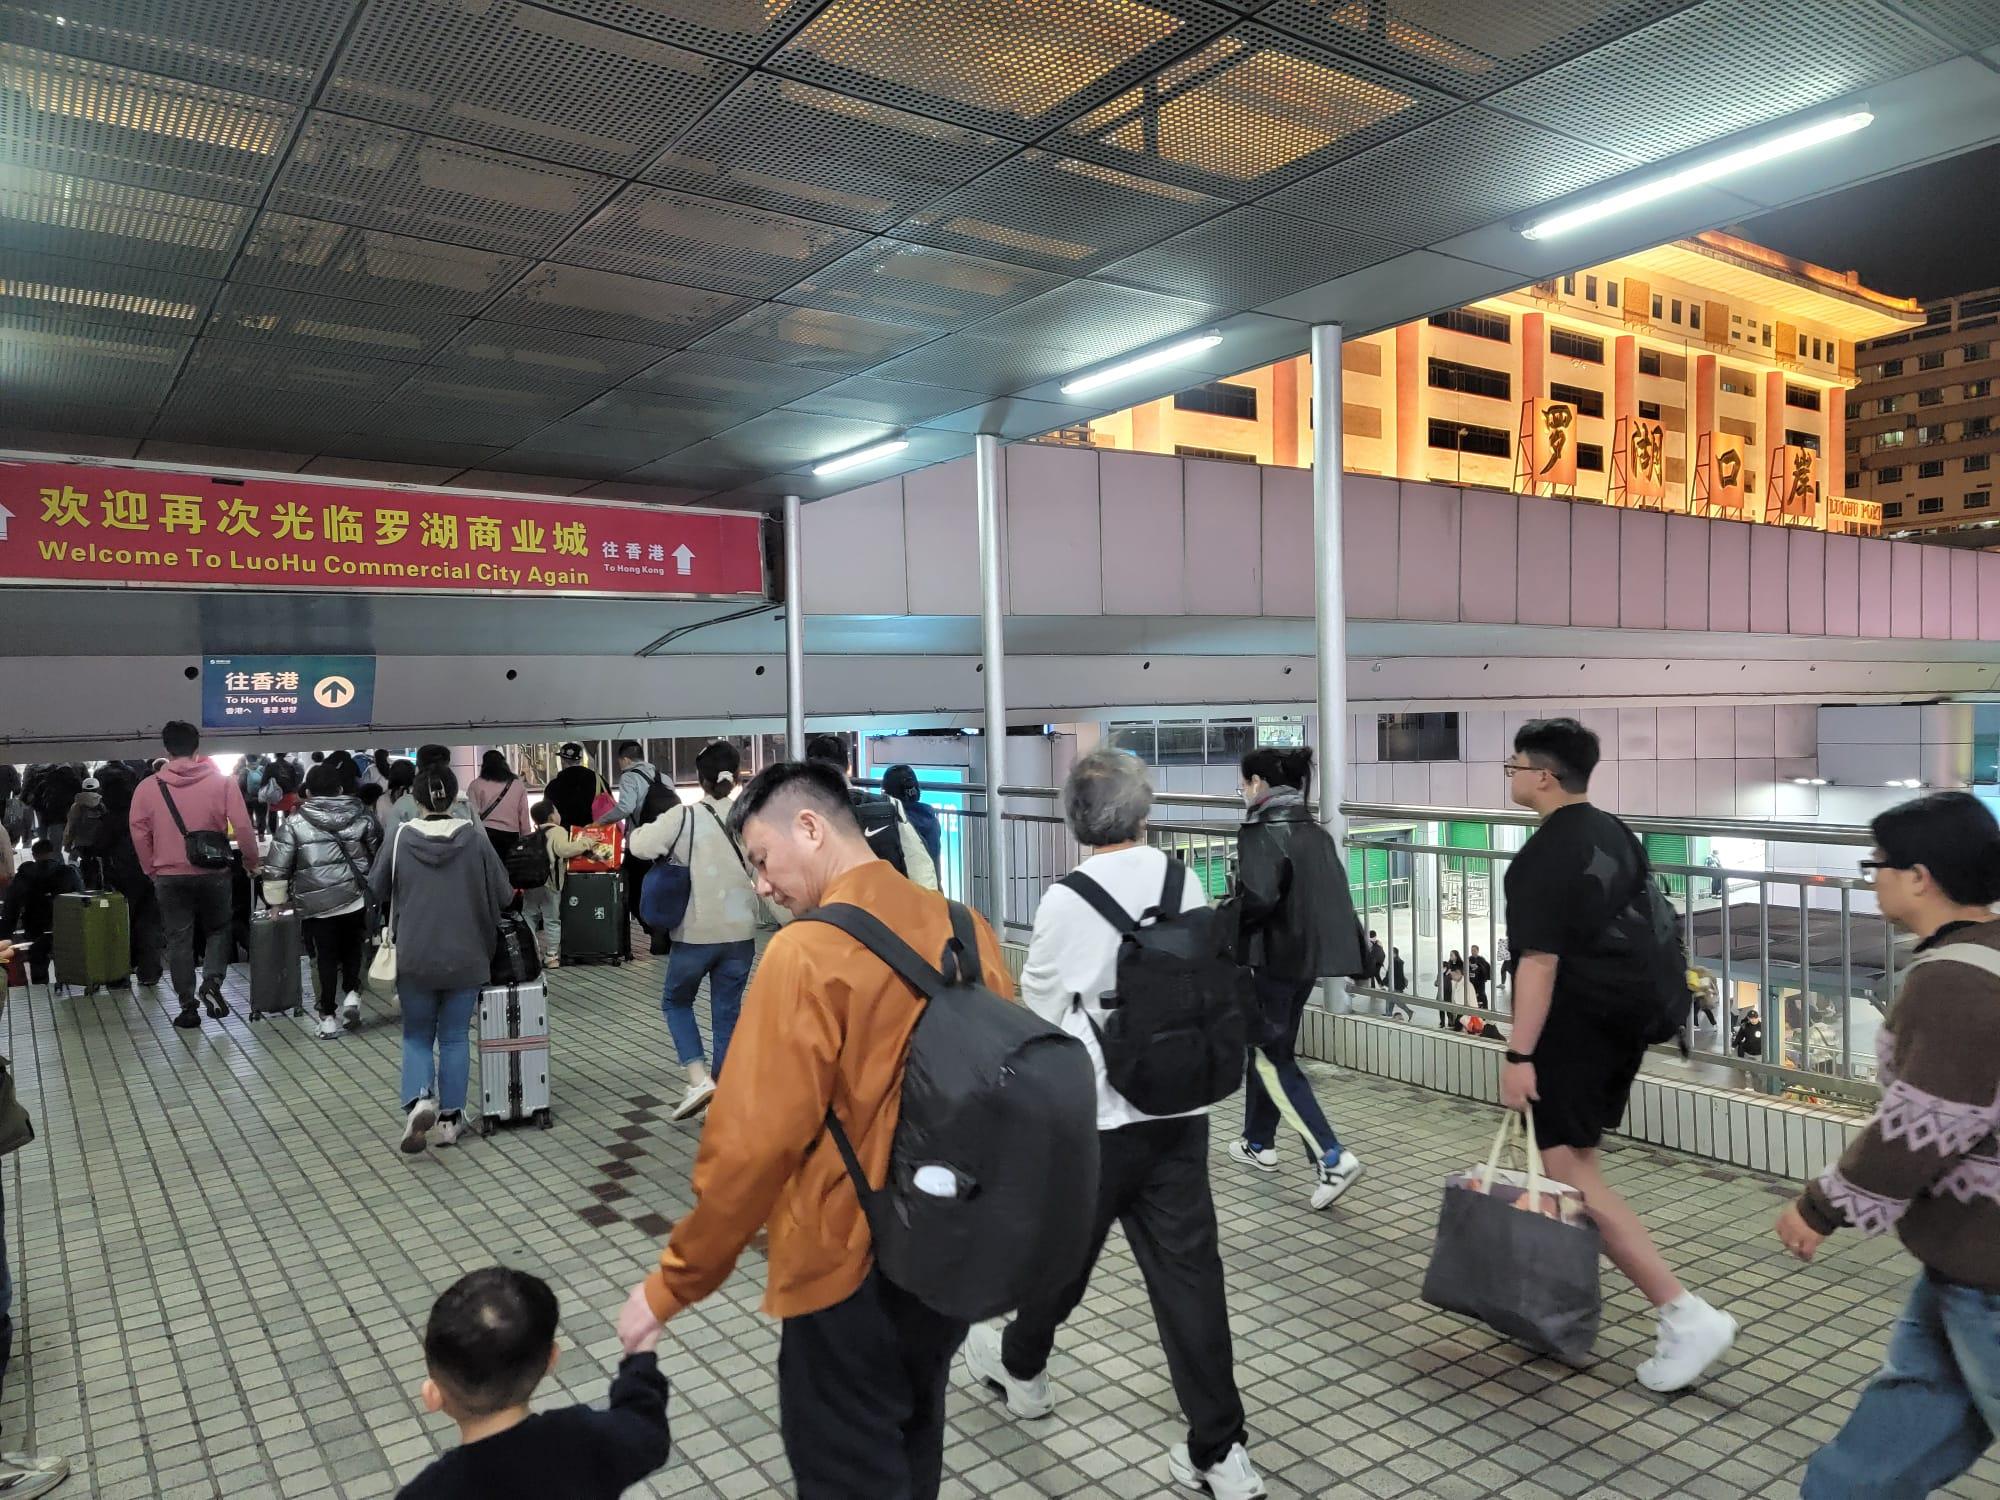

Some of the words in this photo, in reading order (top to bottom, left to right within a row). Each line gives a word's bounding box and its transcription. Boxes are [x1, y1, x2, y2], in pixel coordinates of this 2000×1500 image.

[39, 485, 589, 558] 欢迎再次光临罗湖商业城
[602, 541, 665, 561] 往香港
[38, 540, 179, 567] Welcome
[186, 548, 222, 569] To
[230, 550, 317, 574] LuoHu
[324, 555, 471, 580] Commercial
[477, 563, 520, 586] City
[527, 566, 590, 588] Again
[604, 563, 616, 572] To
[617, 564, 641, 575] Hong
[641, 565, 665, 576] Kong
[225, 671, 299, 691] 往香港
[225, 696, 239, 704] To
[240, 696, 269, 705] Hong
[270, 695, 298, 704] Kong
